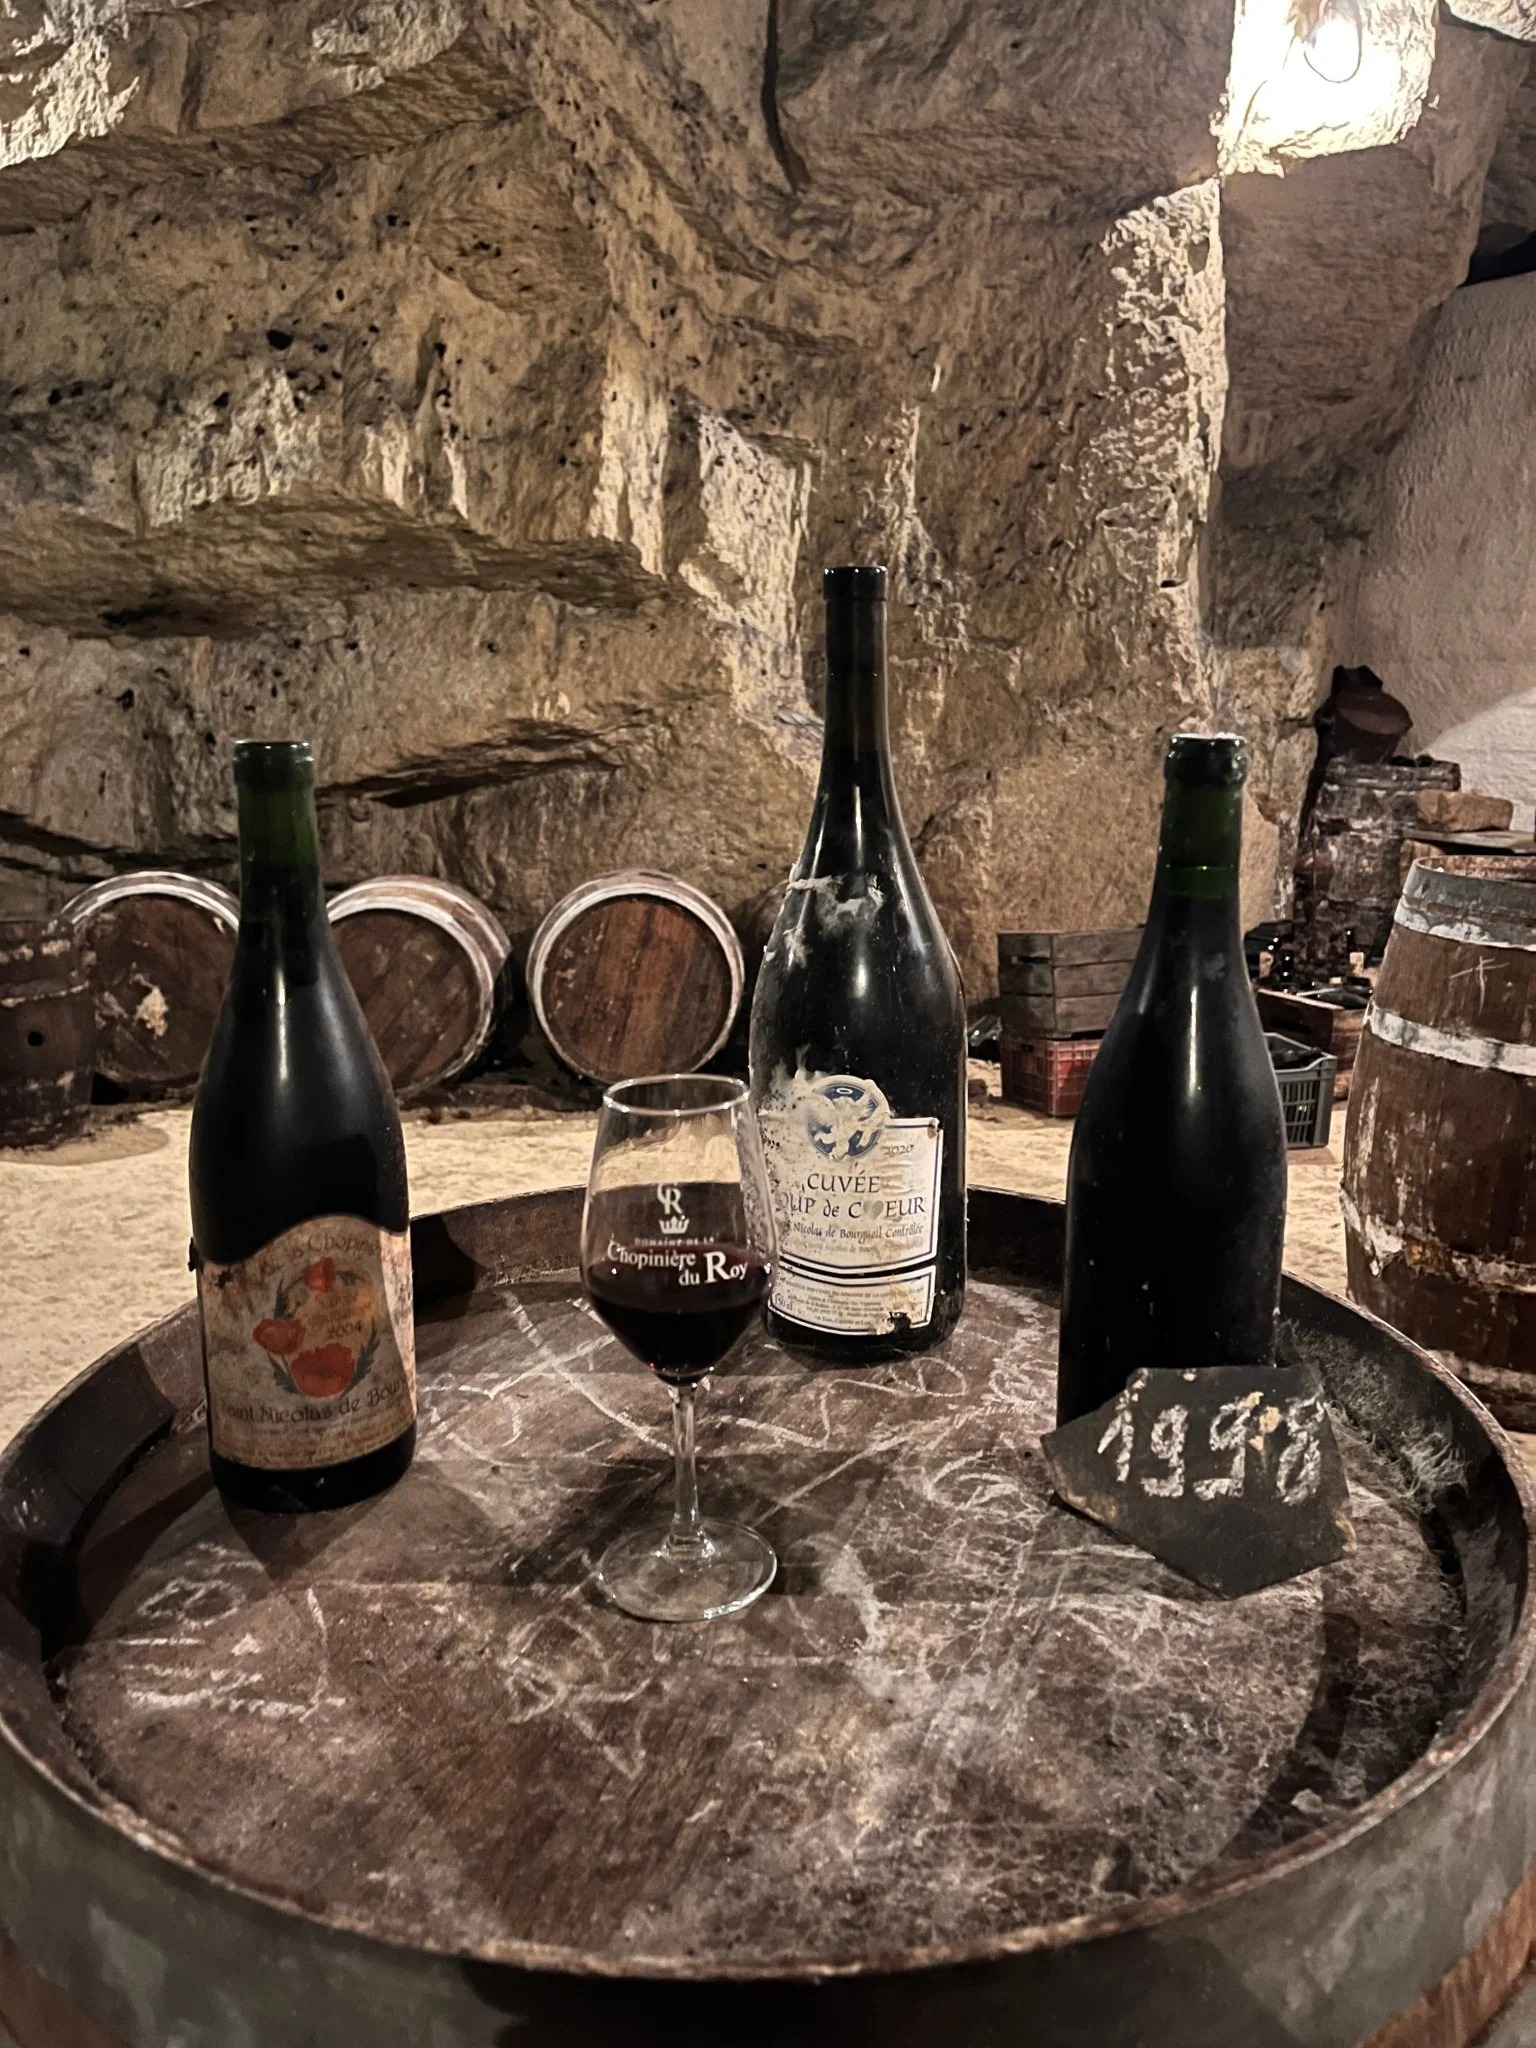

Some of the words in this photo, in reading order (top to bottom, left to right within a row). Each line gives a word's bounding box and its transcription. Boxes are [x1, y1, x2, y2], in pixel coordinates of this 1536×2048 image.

[807, 1170, 881, 1194] CUVÉE
[823, 1200, 840, 1218] de
[825, 1225, 836, 1238] de
[839, 1226, 883, 1244] Bourgueil
[606, 1239, 697, 1270] Chopinière
[678, 1269, 701, 1286] du
[703, 1250, 749, 1284] Roy
[259, 1404, 333, 1425] Nicolas
[338, 1398, 362, 1415] de
[1097, 1391, 1328, 1504] 1998
